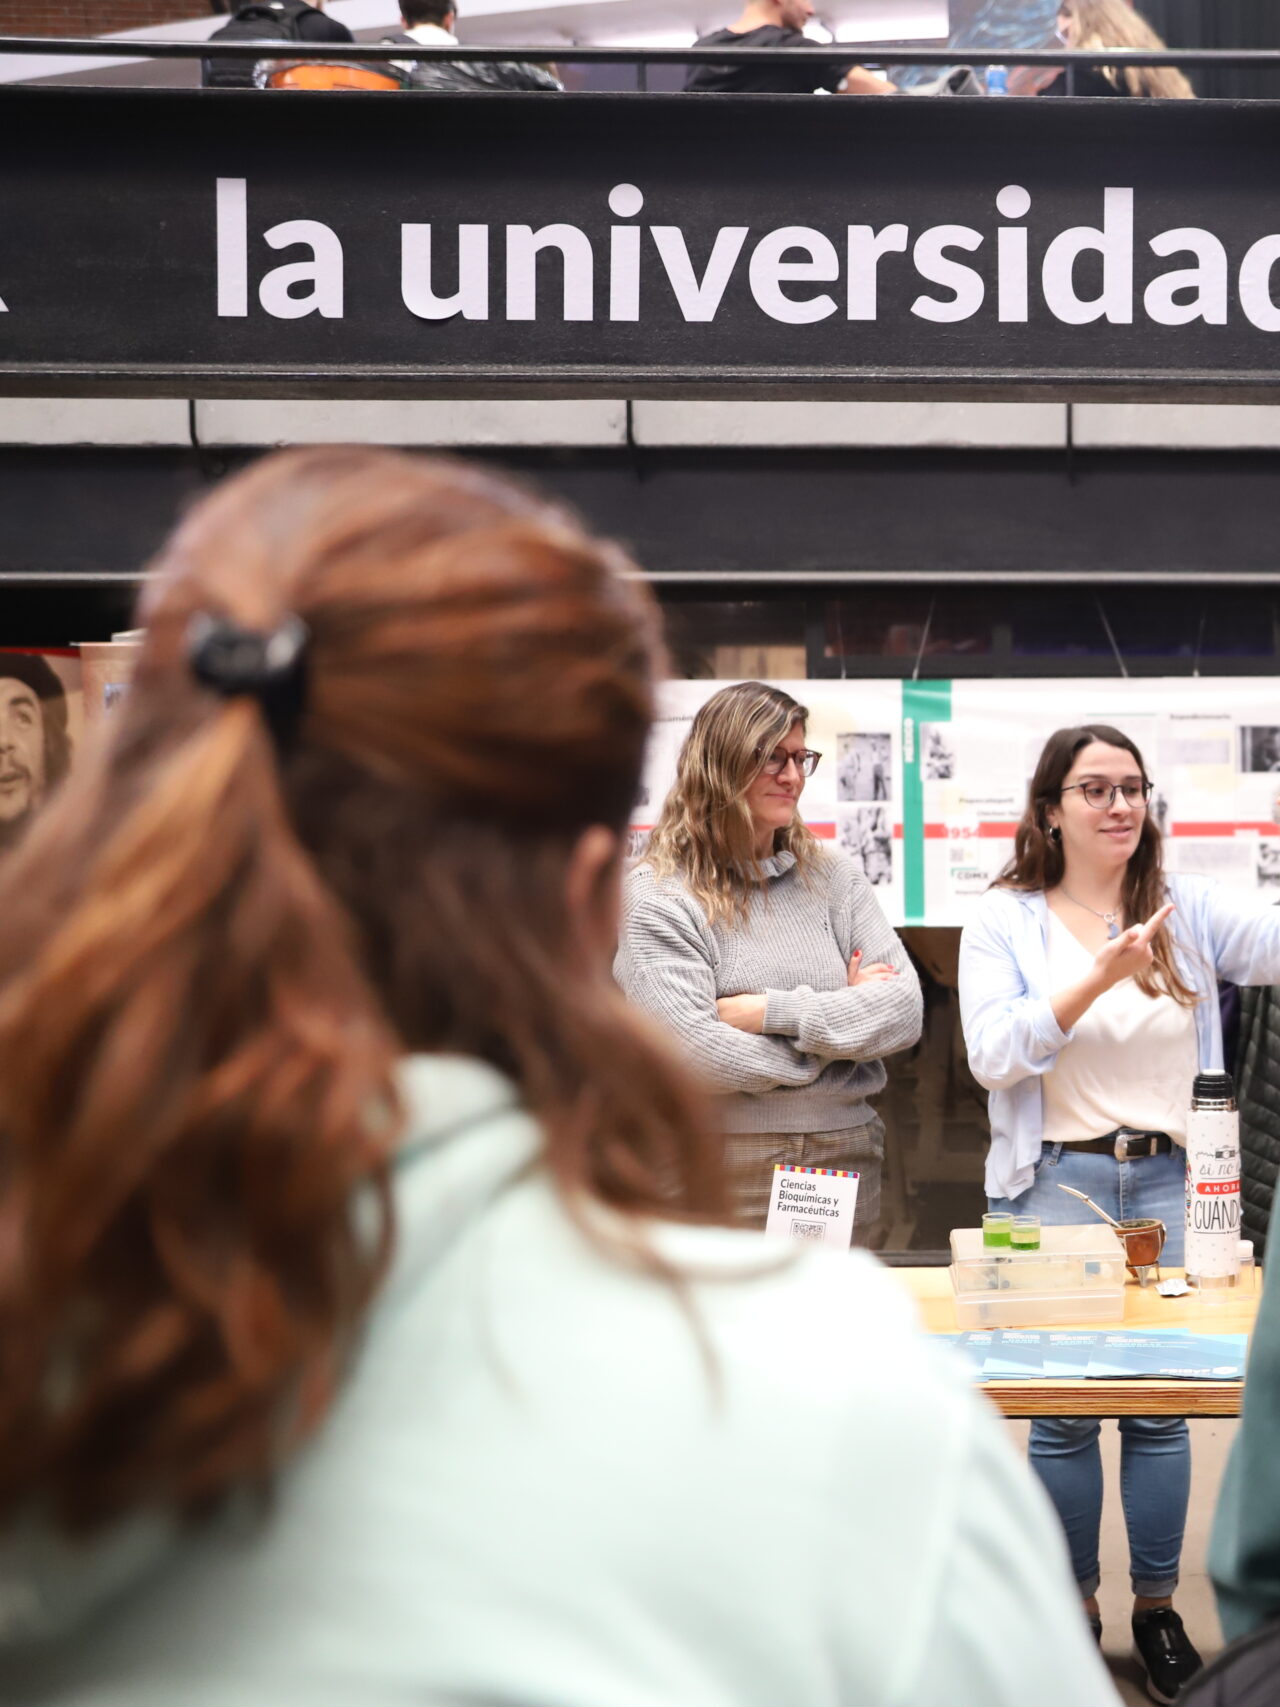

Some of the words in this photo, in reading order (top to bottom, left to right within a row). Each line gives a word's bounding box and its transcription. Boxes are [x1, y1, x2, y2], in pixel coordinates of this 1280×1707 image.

[216, 177, 344, 320] la
[780, 1179, 816, 1191] Ciencias
[778, 1190, 832, 1205] Bioquímicas
[834, 1198, 839, 1206] y
[777, 1201, 839, 1217] Farmacéuticas
